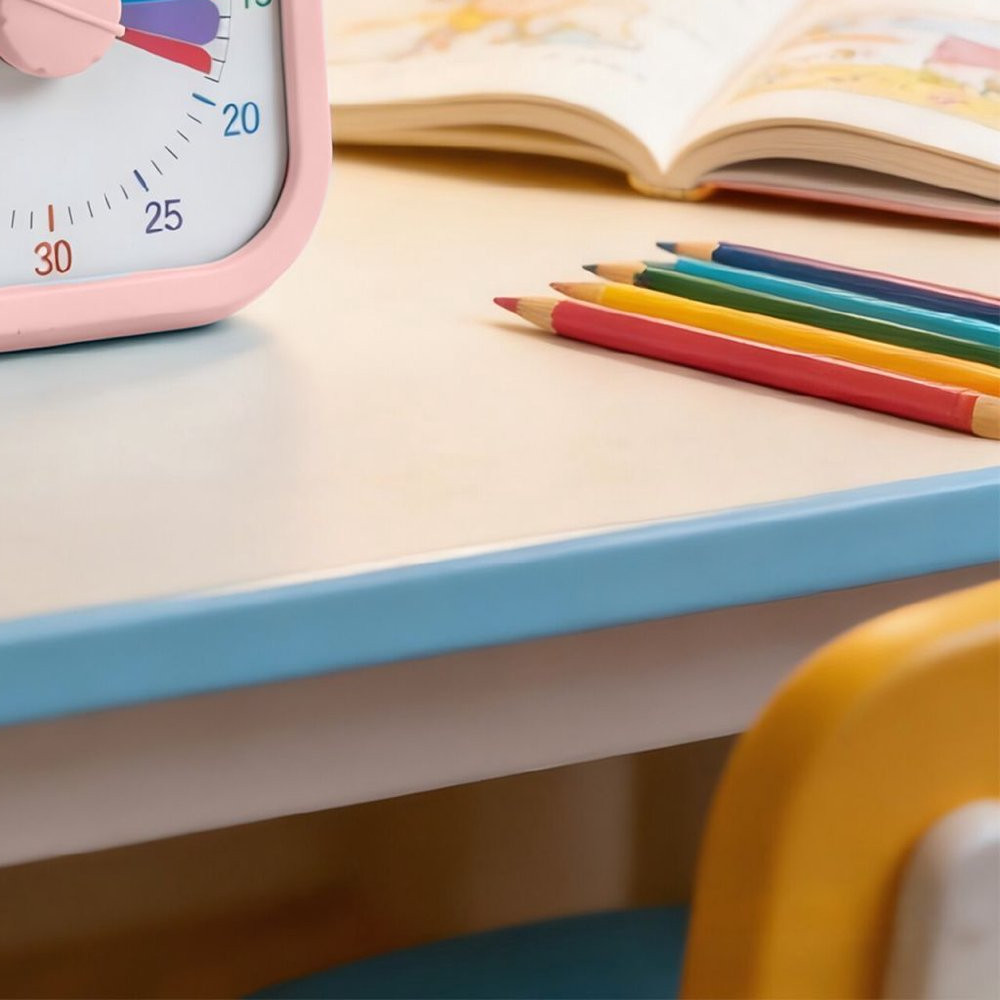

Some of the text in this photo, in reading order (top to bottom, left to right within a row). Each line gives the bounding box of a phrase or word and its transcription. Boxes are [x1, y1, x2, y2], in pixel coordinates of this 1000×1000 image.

[223, 102, 261, 136] 20
[146, 199, 184, 234] 25
[35, 240, 73, 276] 30
